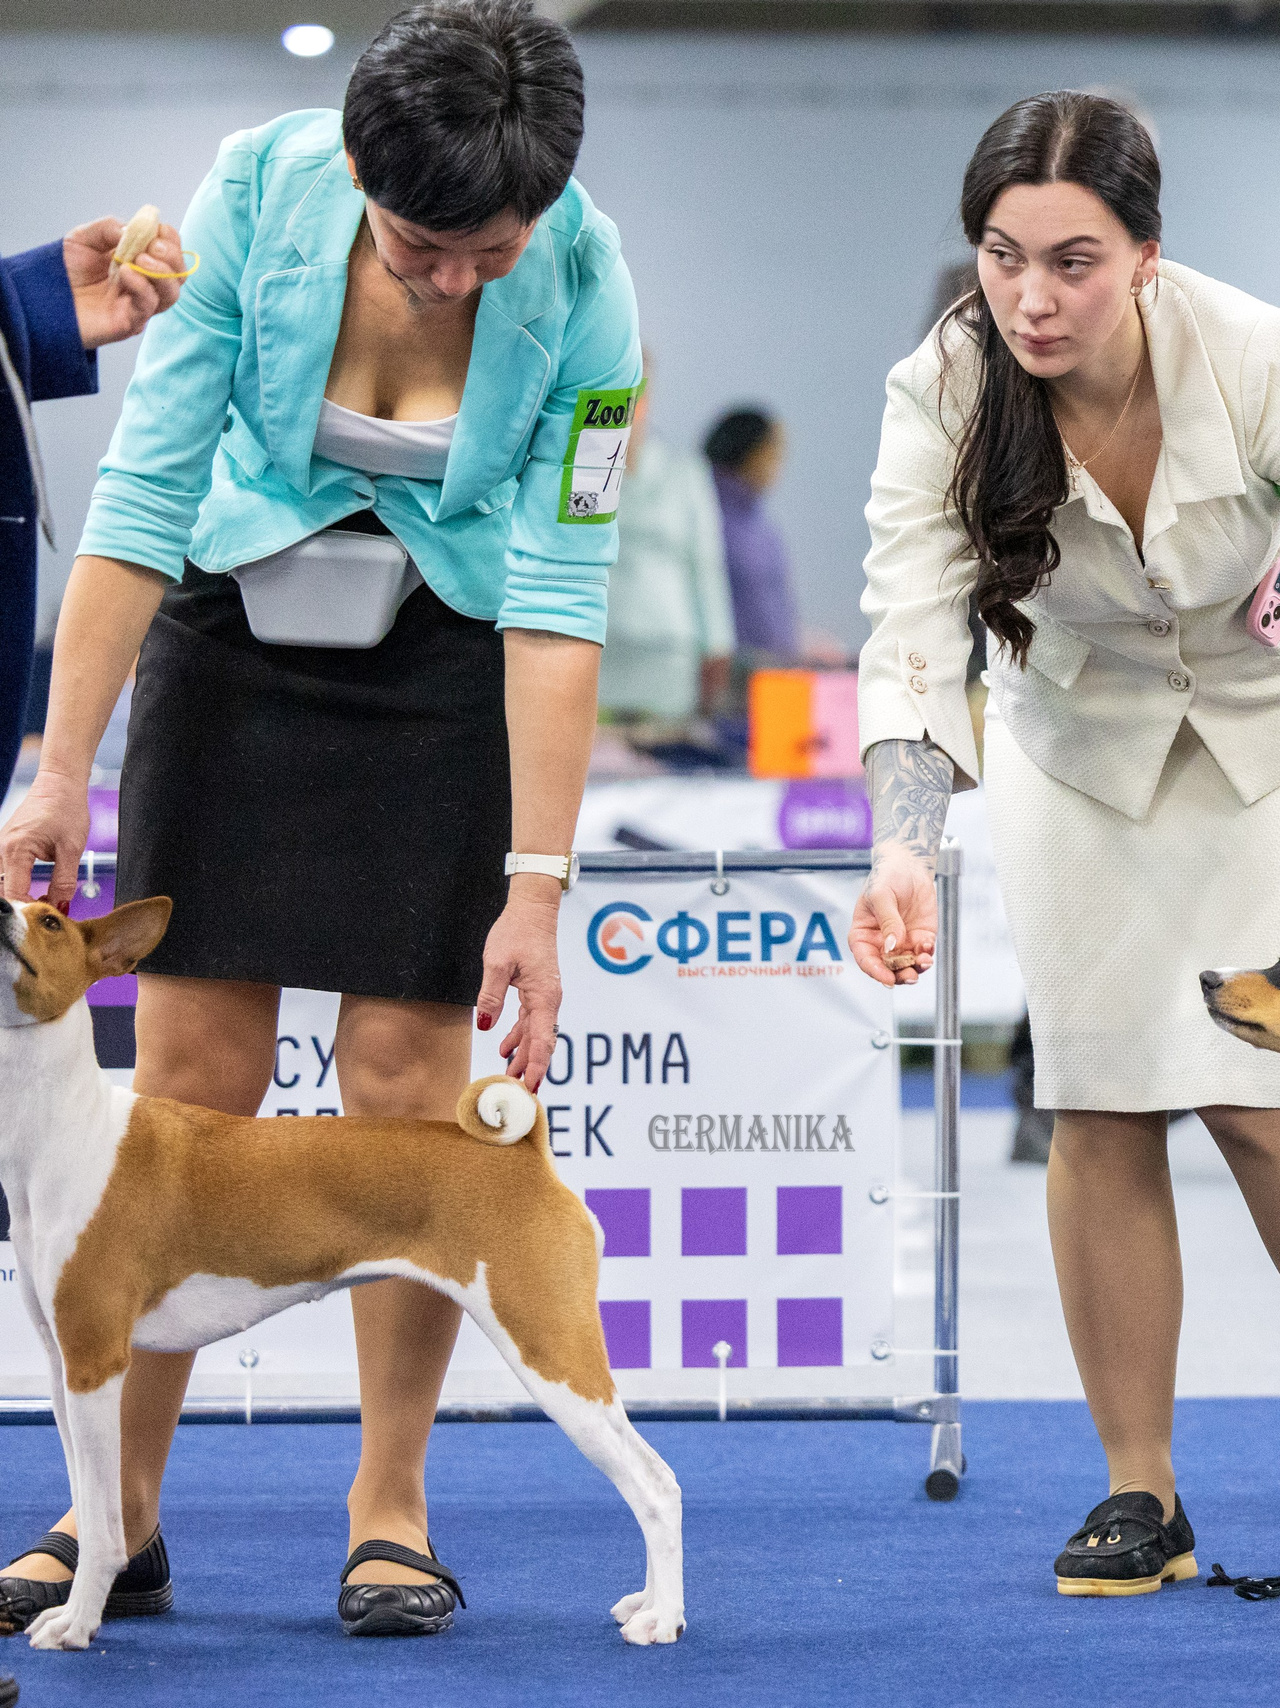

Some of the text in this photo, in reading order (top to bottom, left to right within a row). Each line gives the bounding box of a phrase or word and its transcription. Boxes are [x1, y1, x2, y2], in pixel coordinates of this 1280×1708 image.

[587, 901, 843, 974] СФЕРА
[677, 963, 844, 978] ВЫСТАВОЧНЫЙ ЦЕНТР
[508, 1033, 690, 1086] ОРМА
[648, 1114, 855, 1155] GERMANIKA
